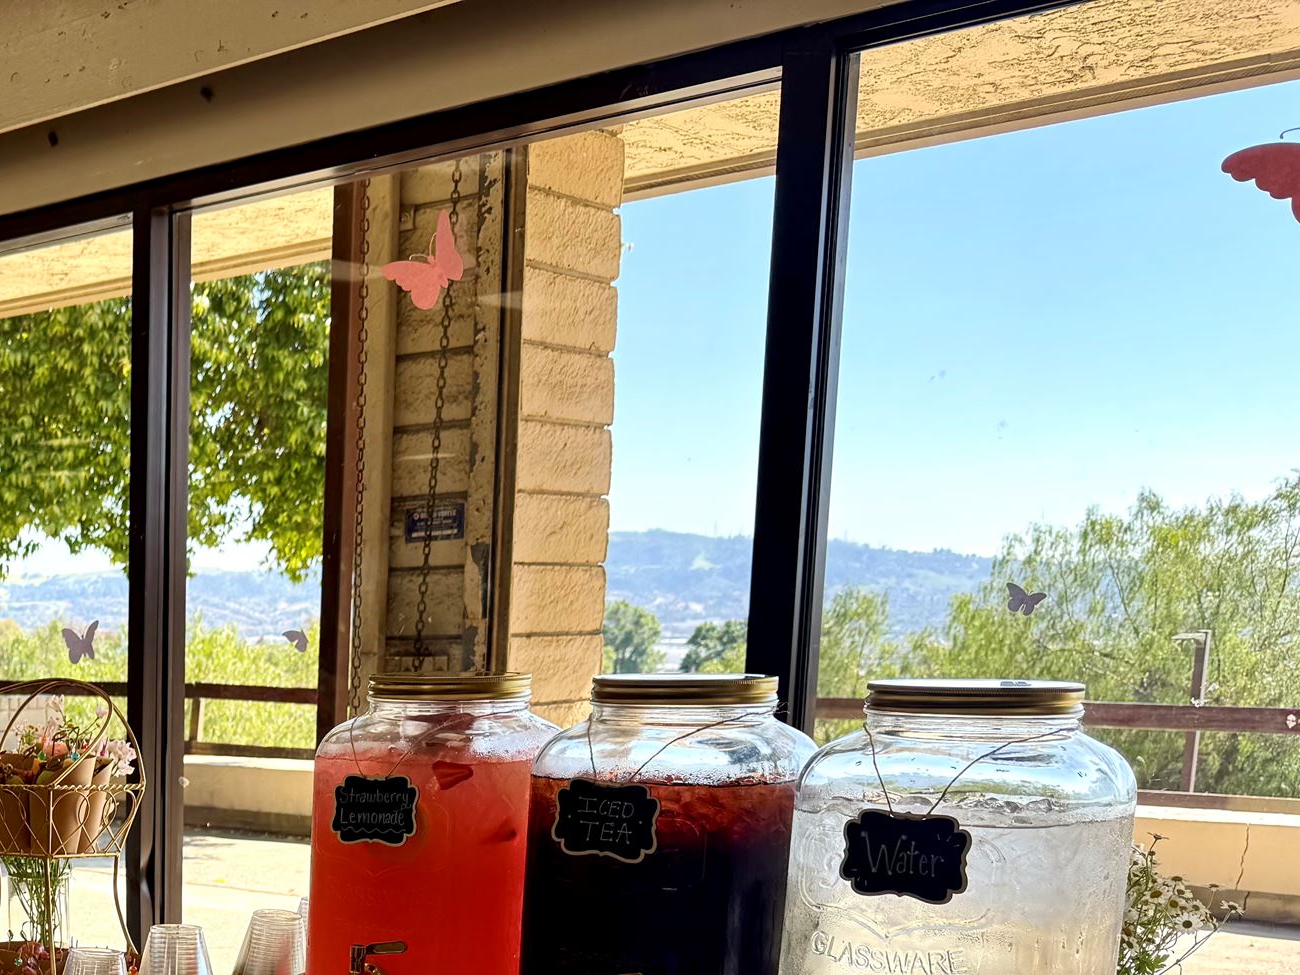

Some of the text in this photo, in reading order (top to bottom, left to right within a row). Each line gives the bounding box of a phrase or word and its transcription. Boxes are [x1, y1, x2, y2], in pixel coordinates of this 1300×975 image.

[340, 787, 411, 809] Strawberry
[577, 796, 635, 819] ICED
[340, 808, 405, 826] Lemonade
[580, 820, 632, 845] TEA
[860, 831, 945, 877] Water
[811, 930, 968, 975] GLASSWARE
